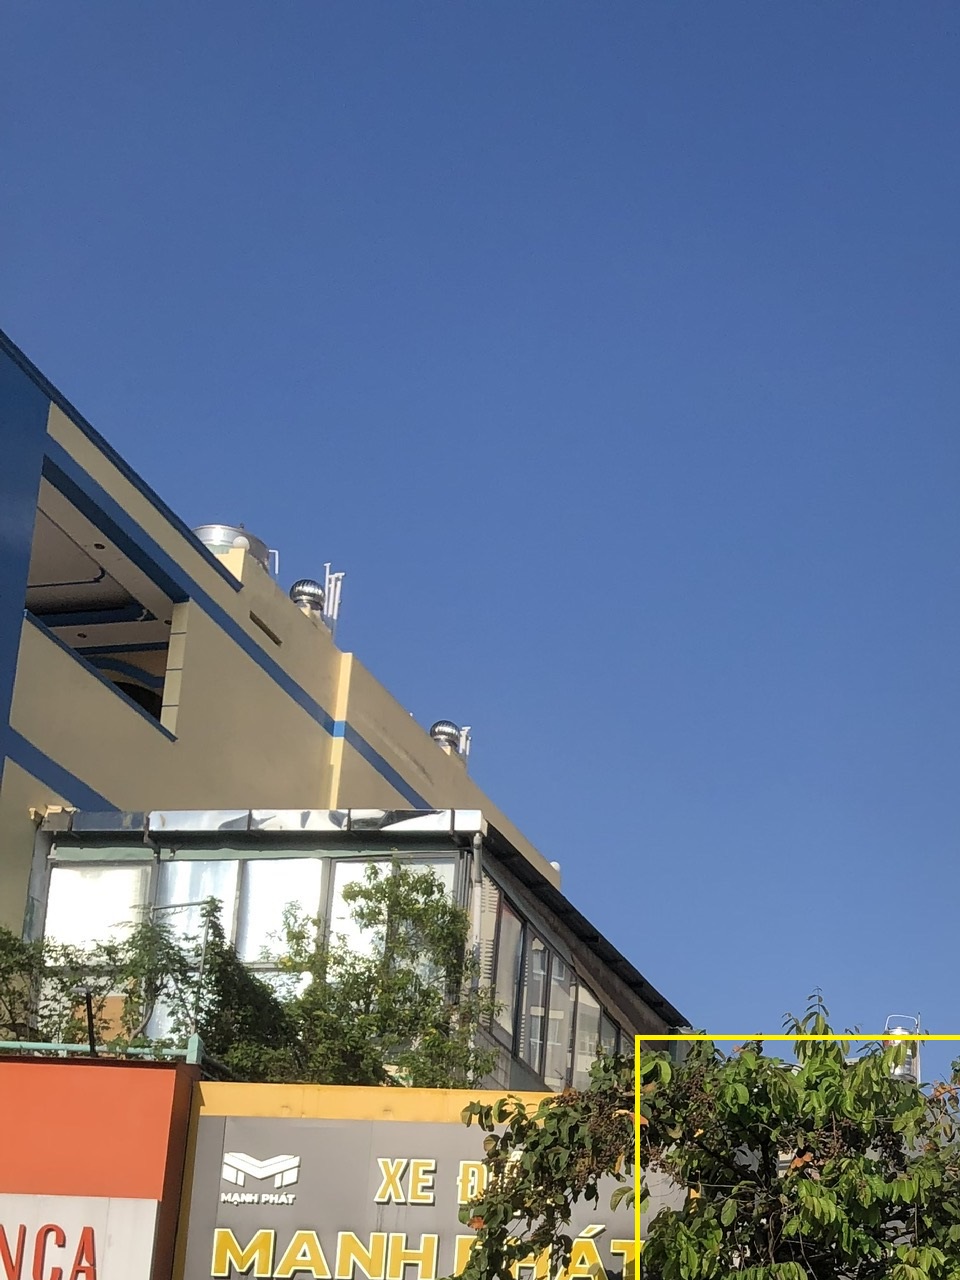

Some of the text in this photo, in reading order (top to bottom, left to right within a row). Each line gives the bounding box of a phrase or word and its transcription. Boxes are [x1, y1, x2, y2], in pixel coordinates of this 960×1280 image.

[374, 1158, 435, 1204] XE
[220, 1191, 296, 1206] MẠNH PHÁT
